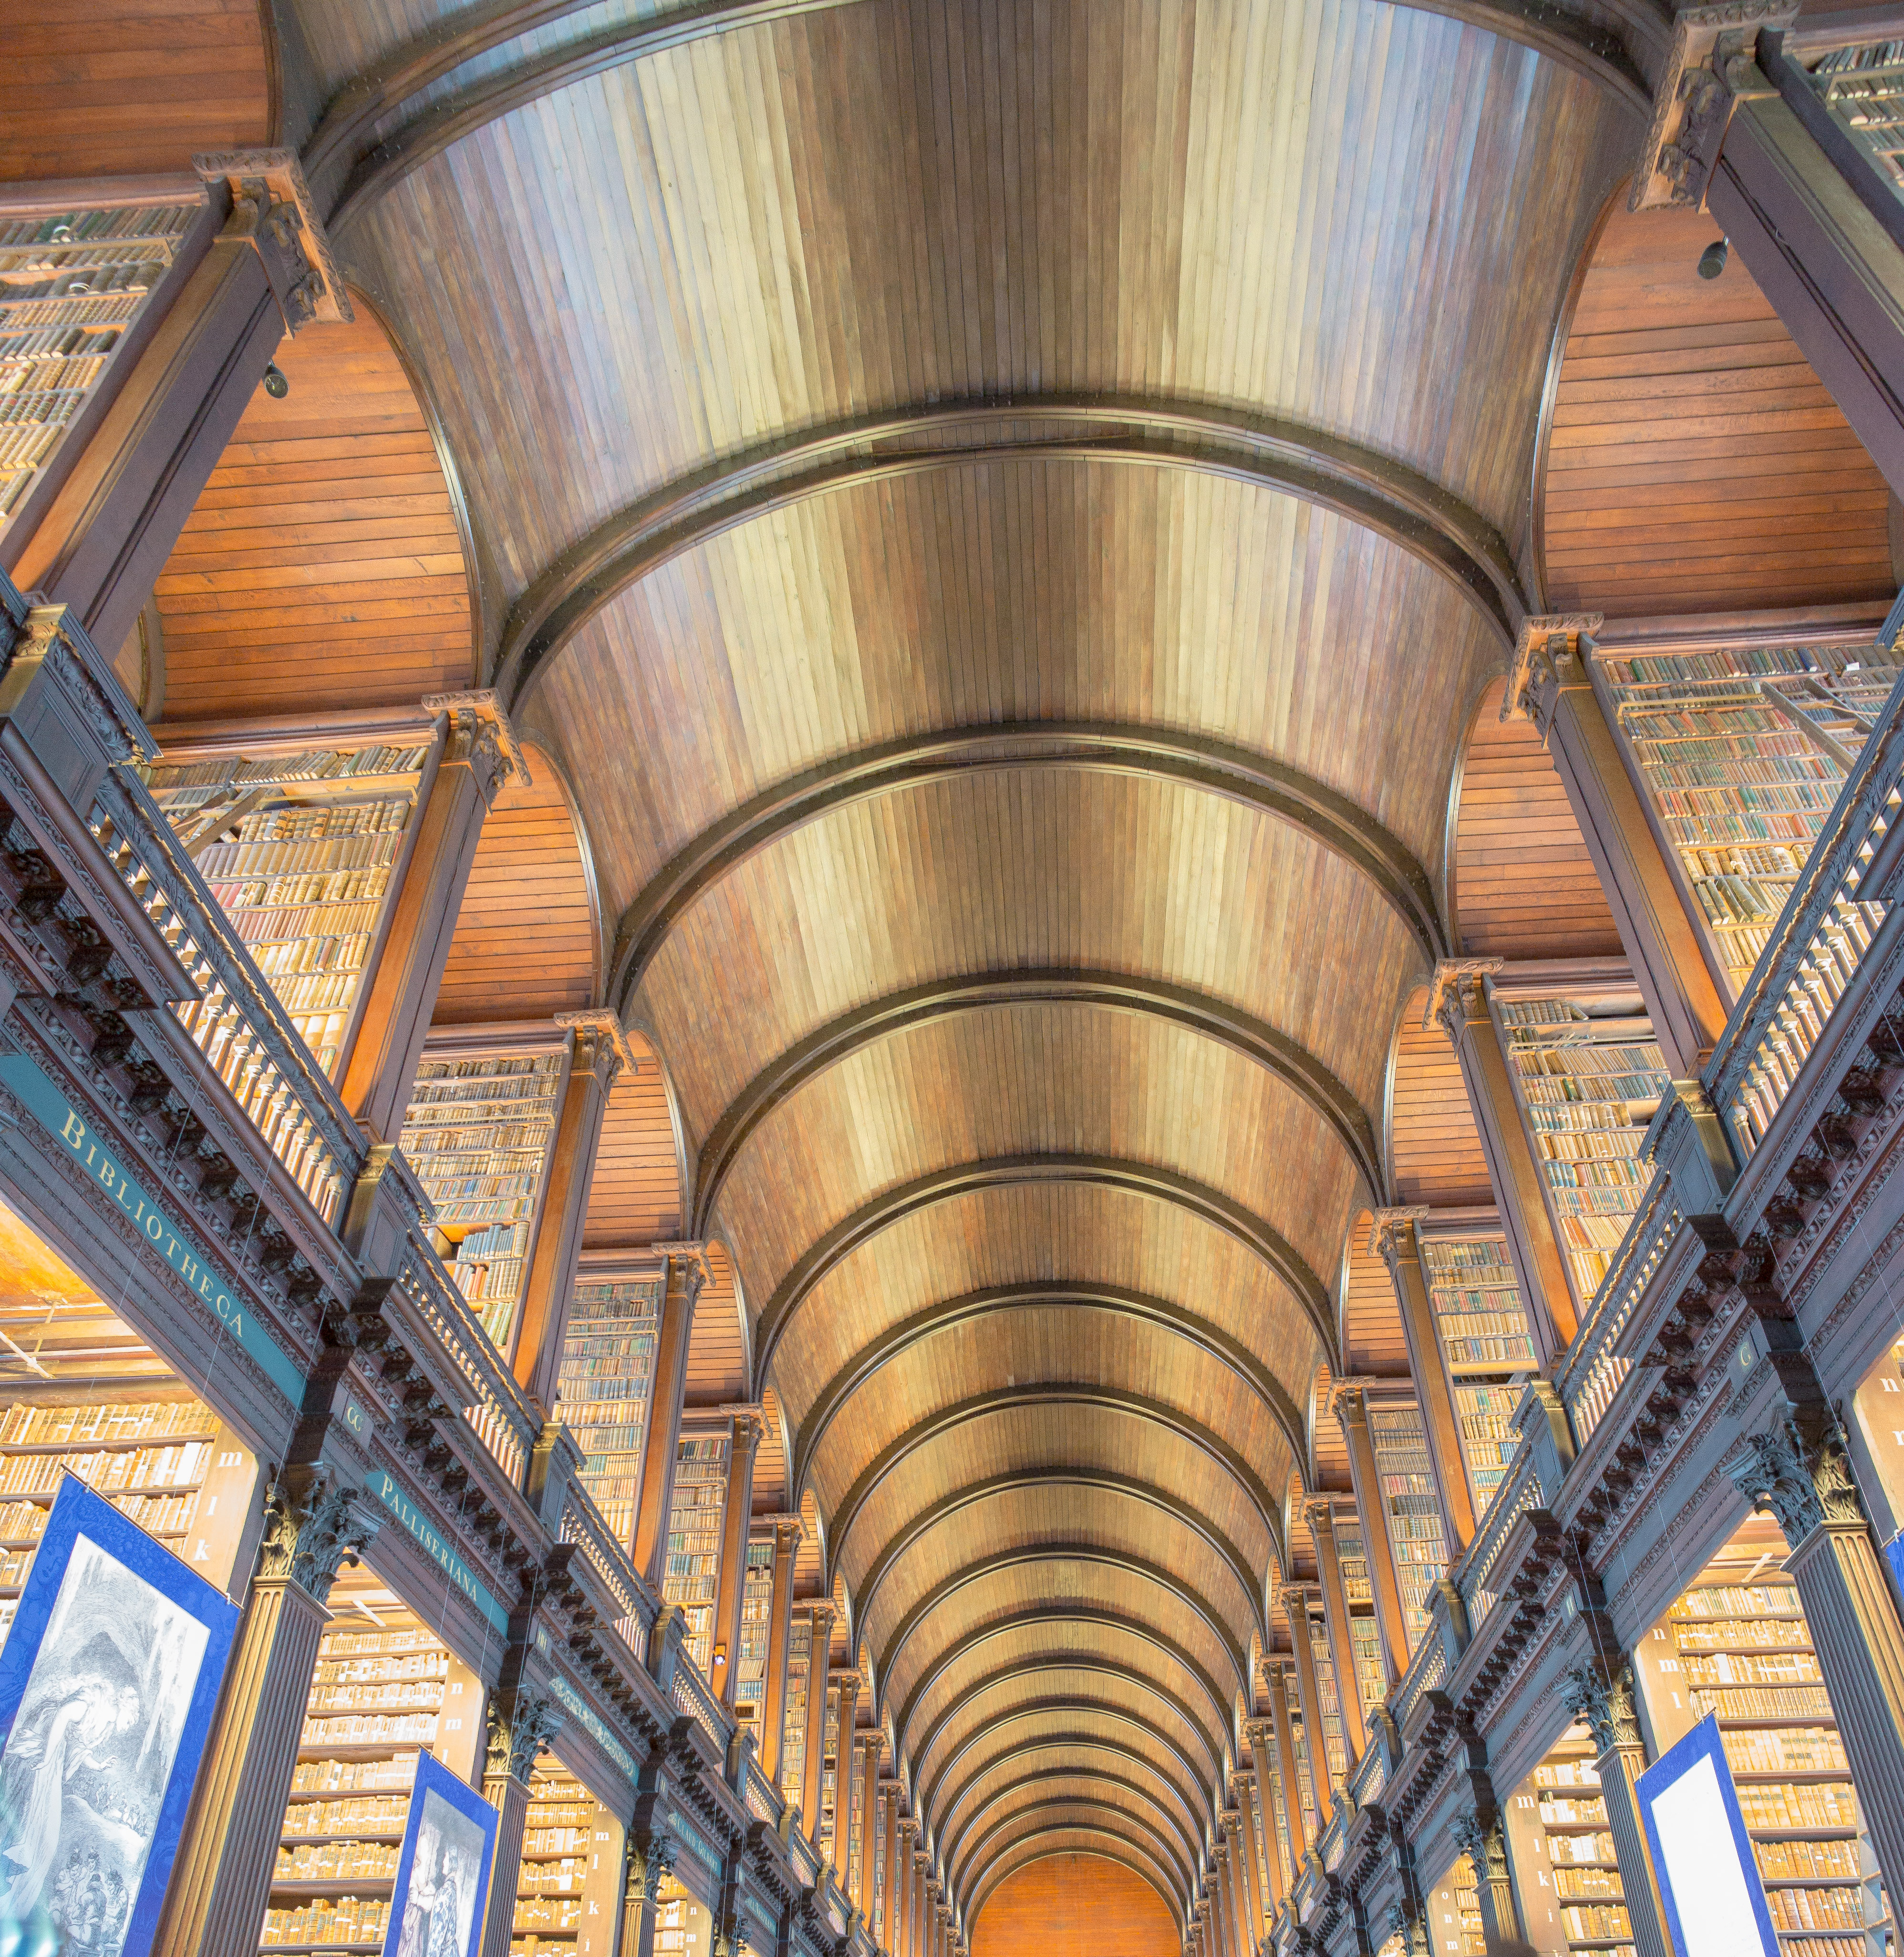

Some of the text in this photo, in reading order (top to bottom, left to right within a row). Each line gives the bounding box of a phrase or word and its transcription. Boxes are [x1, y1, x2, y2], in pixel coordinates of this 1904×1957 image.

[60, 1108, 245, 1338] BIBLIOTHECA
[1880, 1378, 1900, 1392] n
[347, 1407, 363, 1432] CC
[217, 1452, 243, 1467] m
[380, 1474, 478, 1602] PALLISERIANA
[193, 1539, 211, 1561] k
[1652, 1628, 1666, 1640] n
[1658, 1659, 1678, 1672] m
[451, 1683, 463, 1695] n
[445, 1718, 462, 1730] m
[1516, 1795, 1535, 1809] m
[595, 1832, 610, 1841] m
[1537, 1871, 1550, 1886] k
[1441, 1892, 1449, 1900] o
[588, 1900, 600, 1915] k
[690, 1907, 697, 1915] n
[1444, 1914, 1452, 1924] n
[1548, 1908, 1553, 1922] i
[584, 1938, 590, 1952] i
[686, 1934, 696, 1943] m
[1446, 1940, 1459, 1950] m
